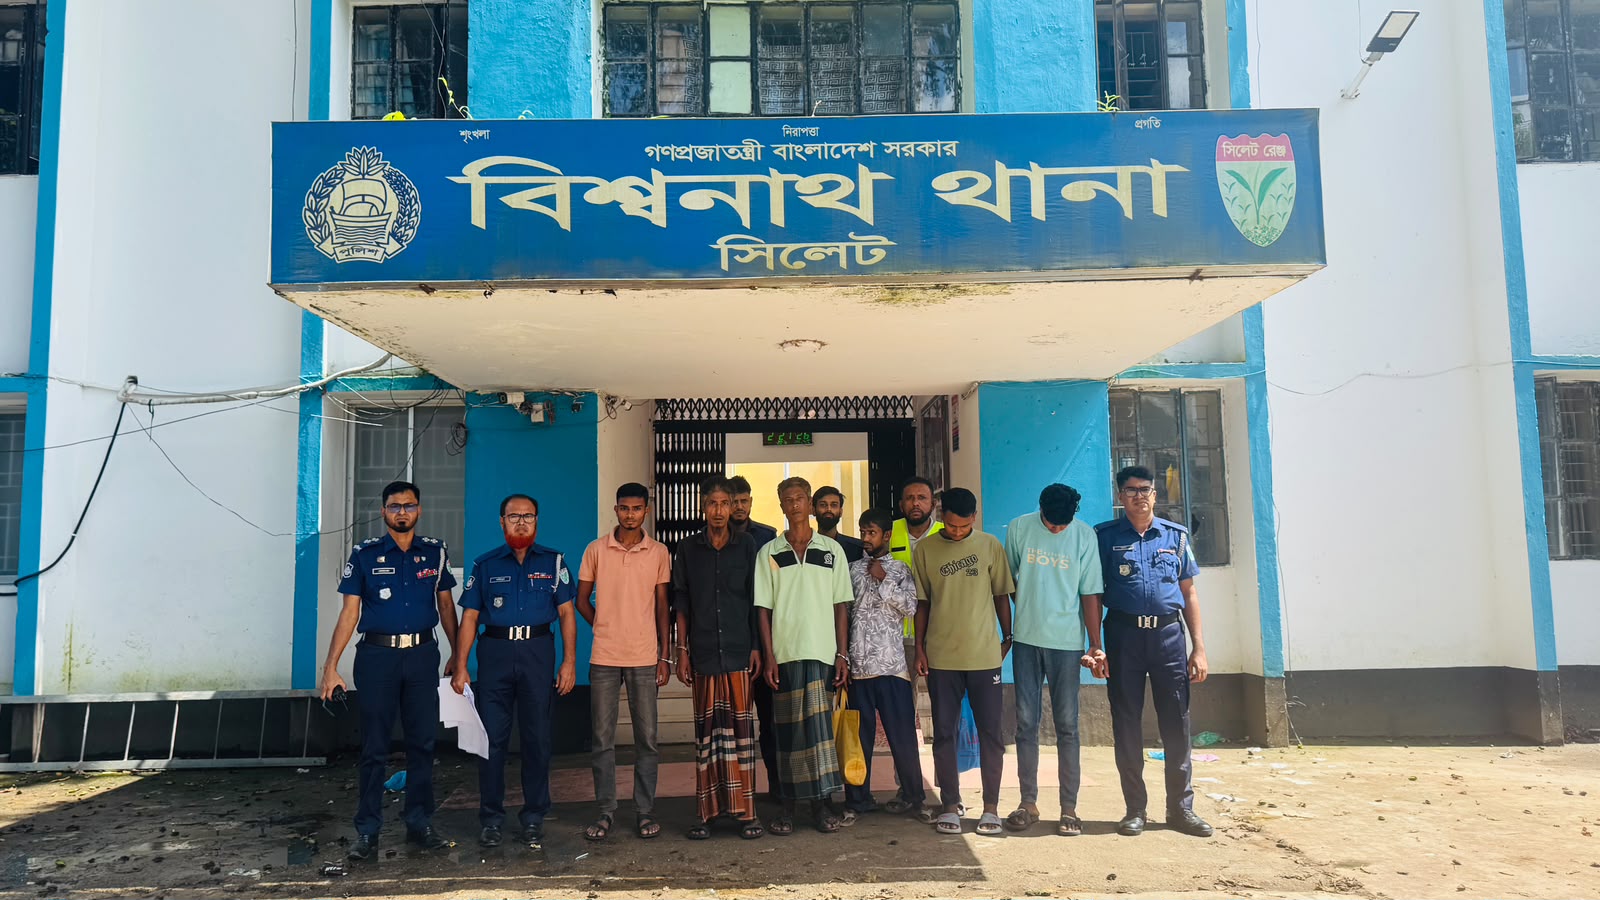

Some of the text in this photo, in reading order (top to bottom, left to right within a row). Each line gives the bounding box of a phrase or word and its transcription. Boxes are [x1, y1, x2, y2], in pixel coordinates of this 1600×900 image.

[1134, 116, 1162, 129] প্রগতি
[458, 129, 491, 144] শৃংখলা
[782, 124, 820, 138] নিরাপত্তা
[644, 138, 960, 162] গণপ্রজাতন্ত্রী বাংলাদেশ সরকার
[1222, 141, 1287, 158] সিলেট রেঞ্জ
[445, 156, 1191, 231] বিশ্বনাথ থানা
[339, 245, 379, 257] পুলিশ
[709, 231, 898, 272] সিলেট
[940, 554, 979, 576] Chicago
[1027, 553, 1070, 569] BOYS
